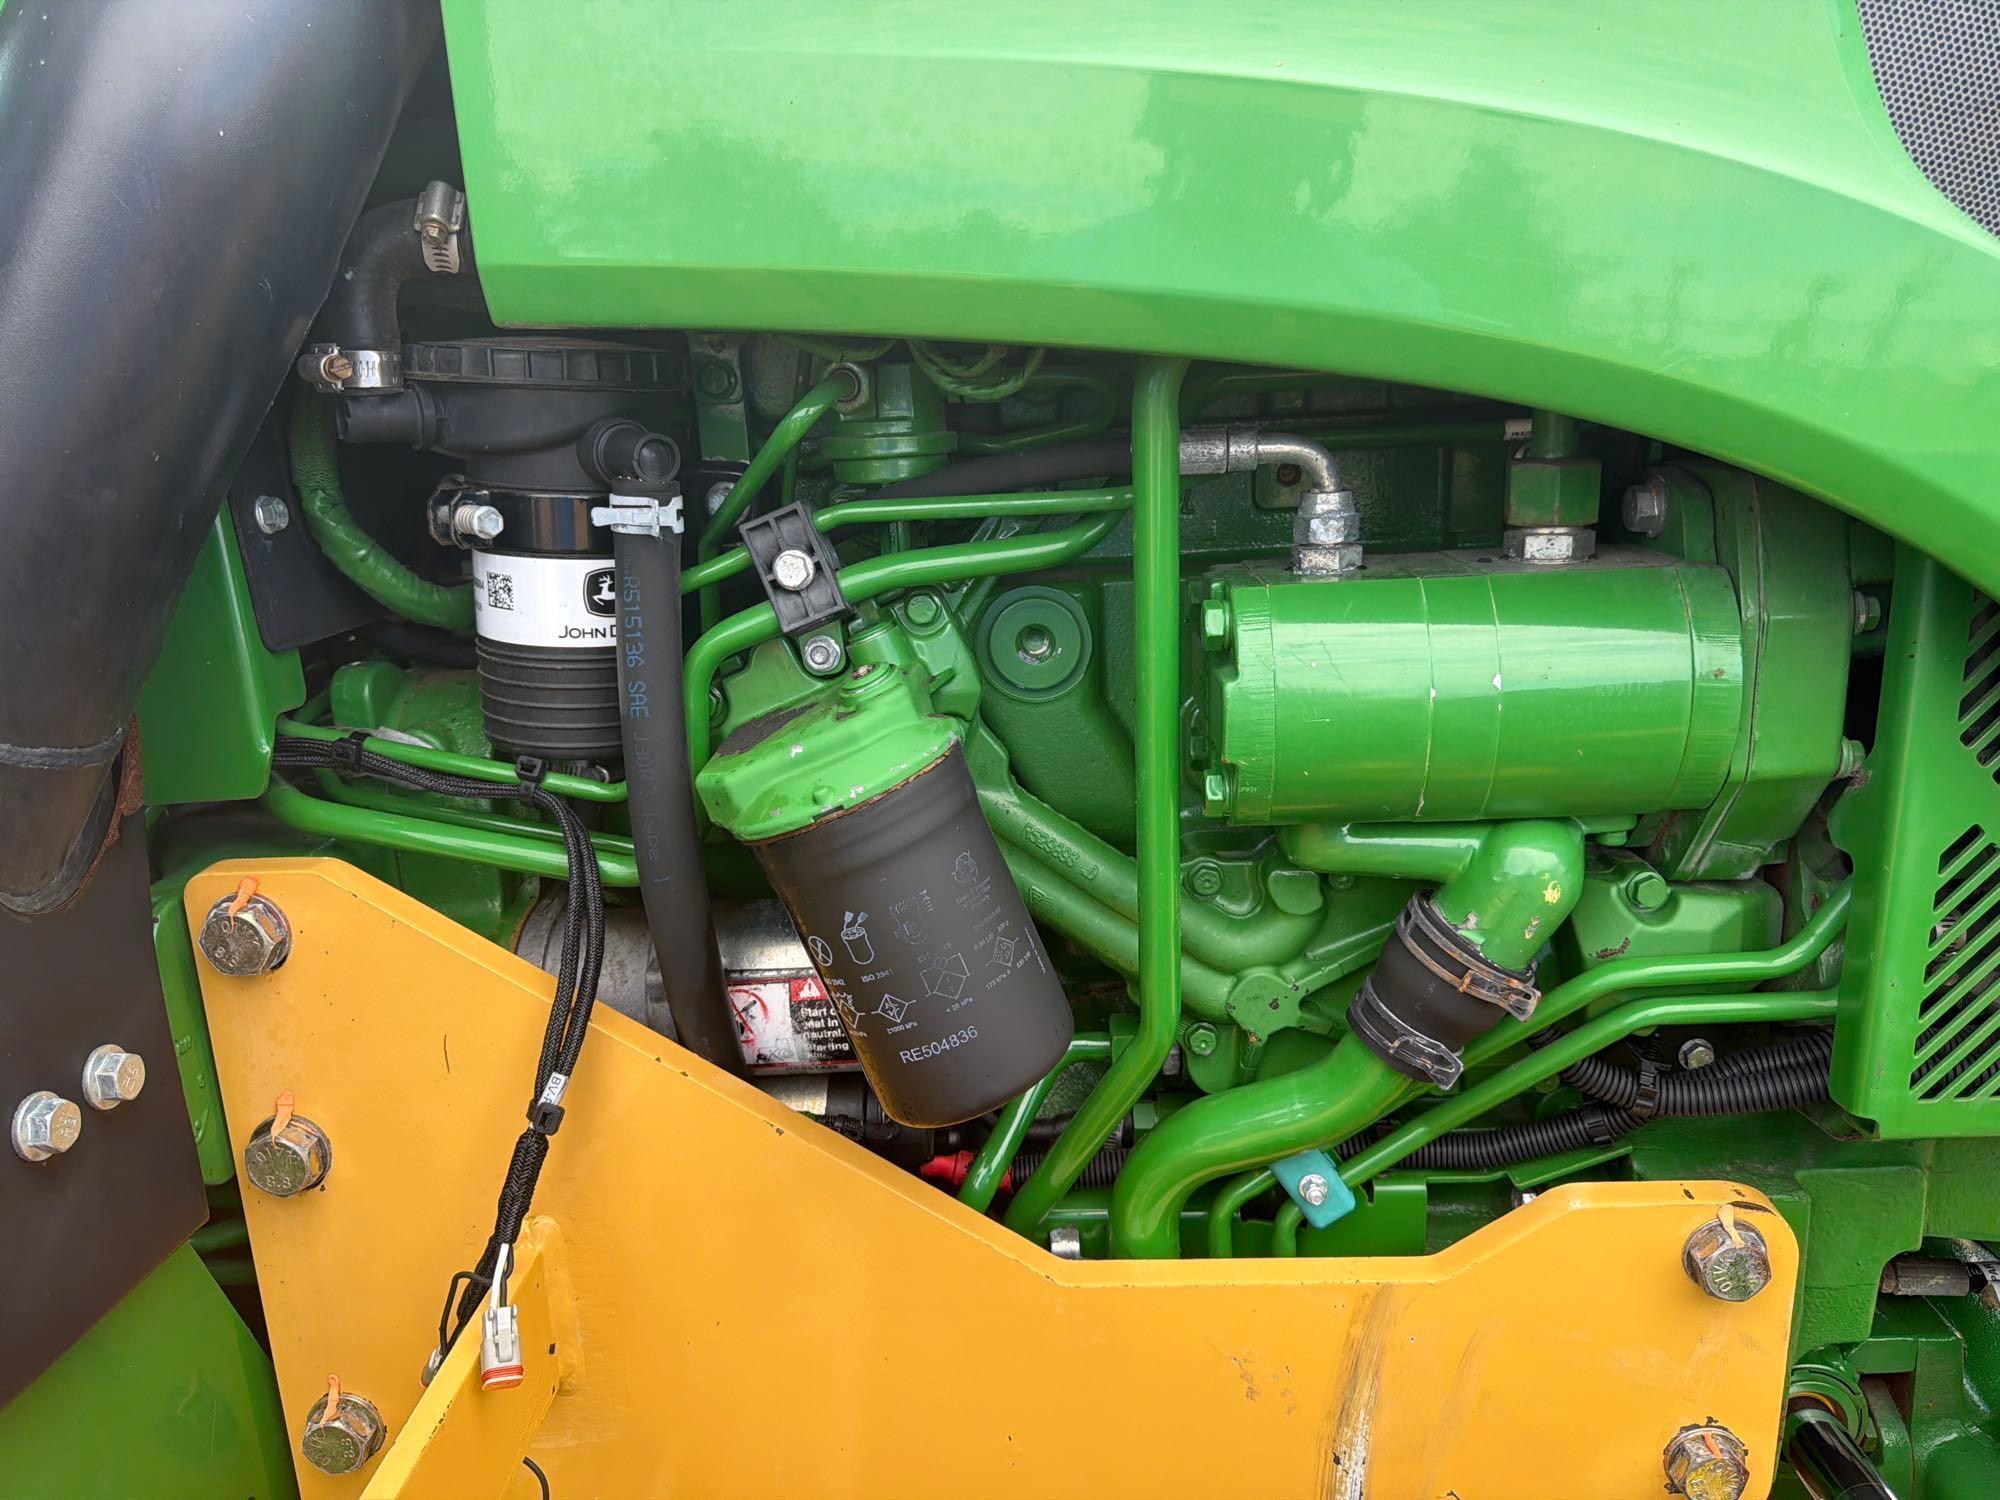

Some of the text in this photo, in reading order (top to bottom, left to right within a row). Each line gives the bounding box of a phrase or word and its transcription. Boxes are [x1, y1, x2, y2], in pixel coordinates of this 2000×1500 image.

[558, 625, 606, 639] JOHN
[623, 576, 646, 668] R515136
[627, 681, 650, 720] SAE
[861, 974, 875, 983] ISO
[899, 1025, 978, 1064] RE504836
